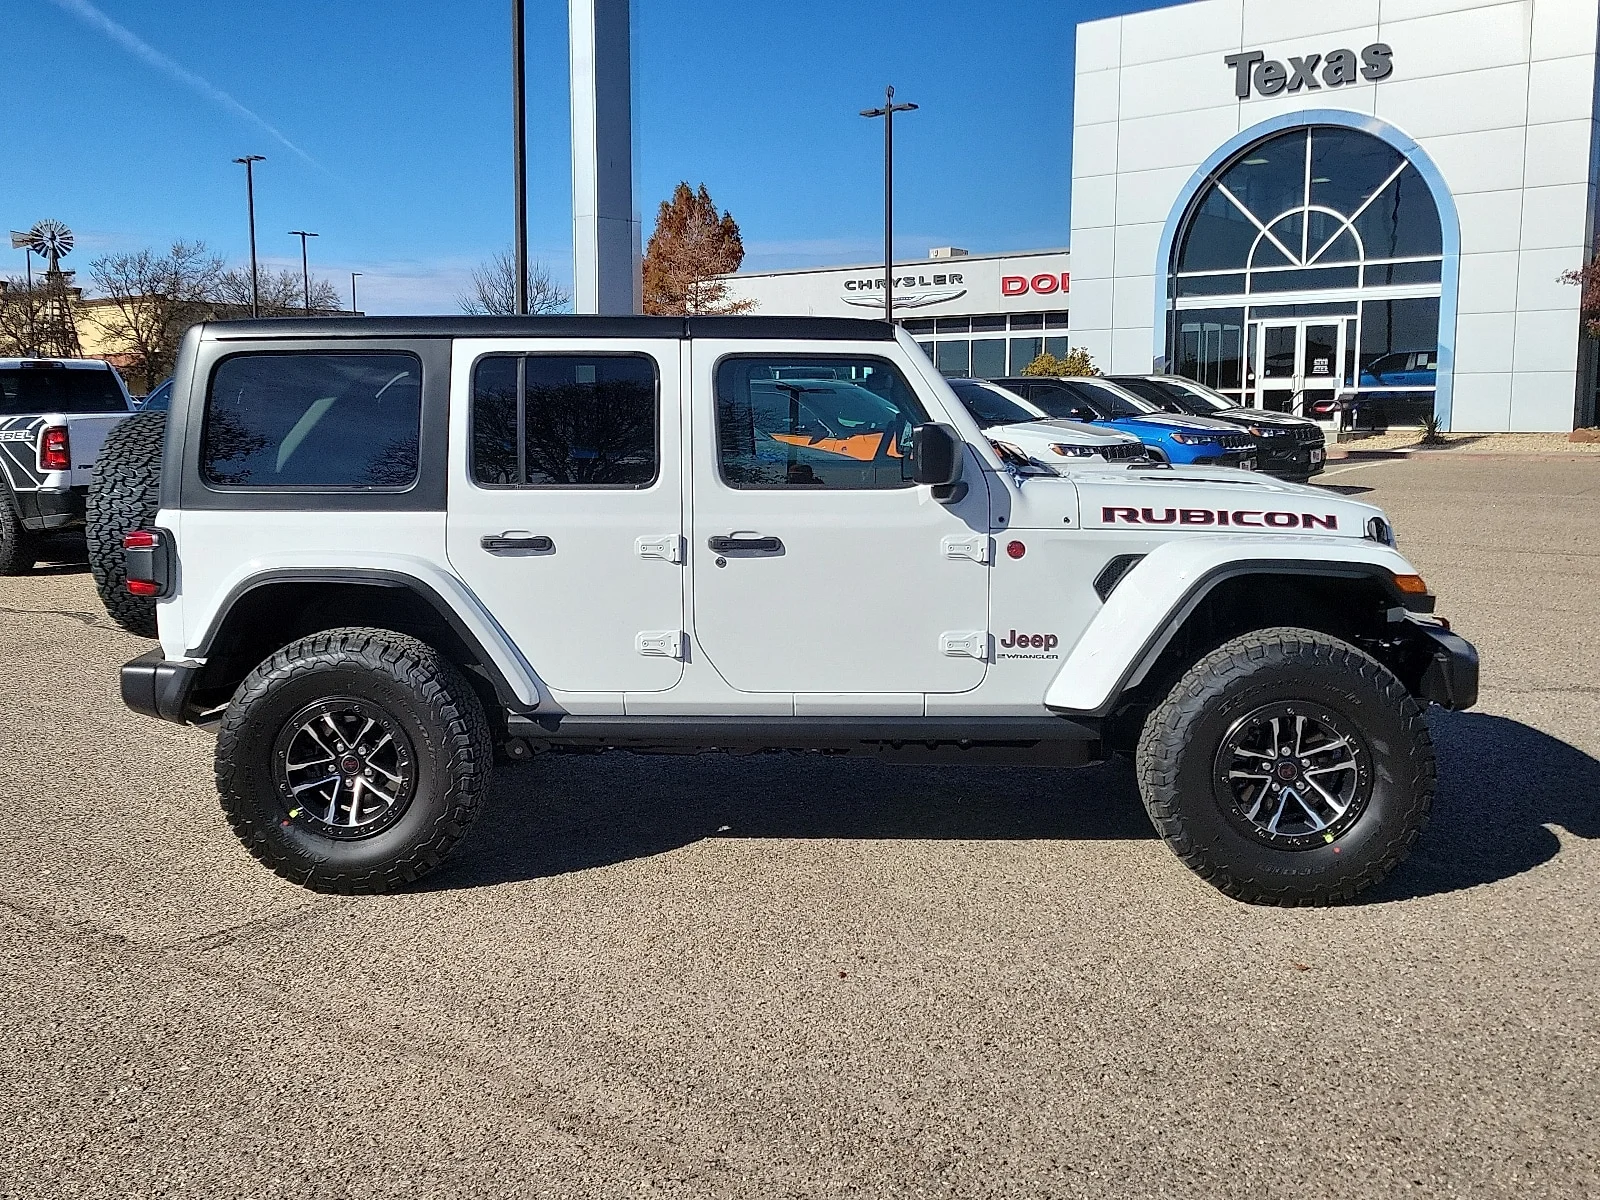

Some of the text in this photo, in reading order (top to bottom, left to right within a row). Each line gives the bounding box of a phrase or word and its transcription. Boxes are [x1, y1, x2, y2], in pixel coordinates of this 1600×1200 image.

[1224, 43, 1393, 99] Texas
[844, 273, 963, 290] CHRYSLER
[1102, 507, 1338, 530] RUBICON
[1000, 629, 1058, 652] Jeep
